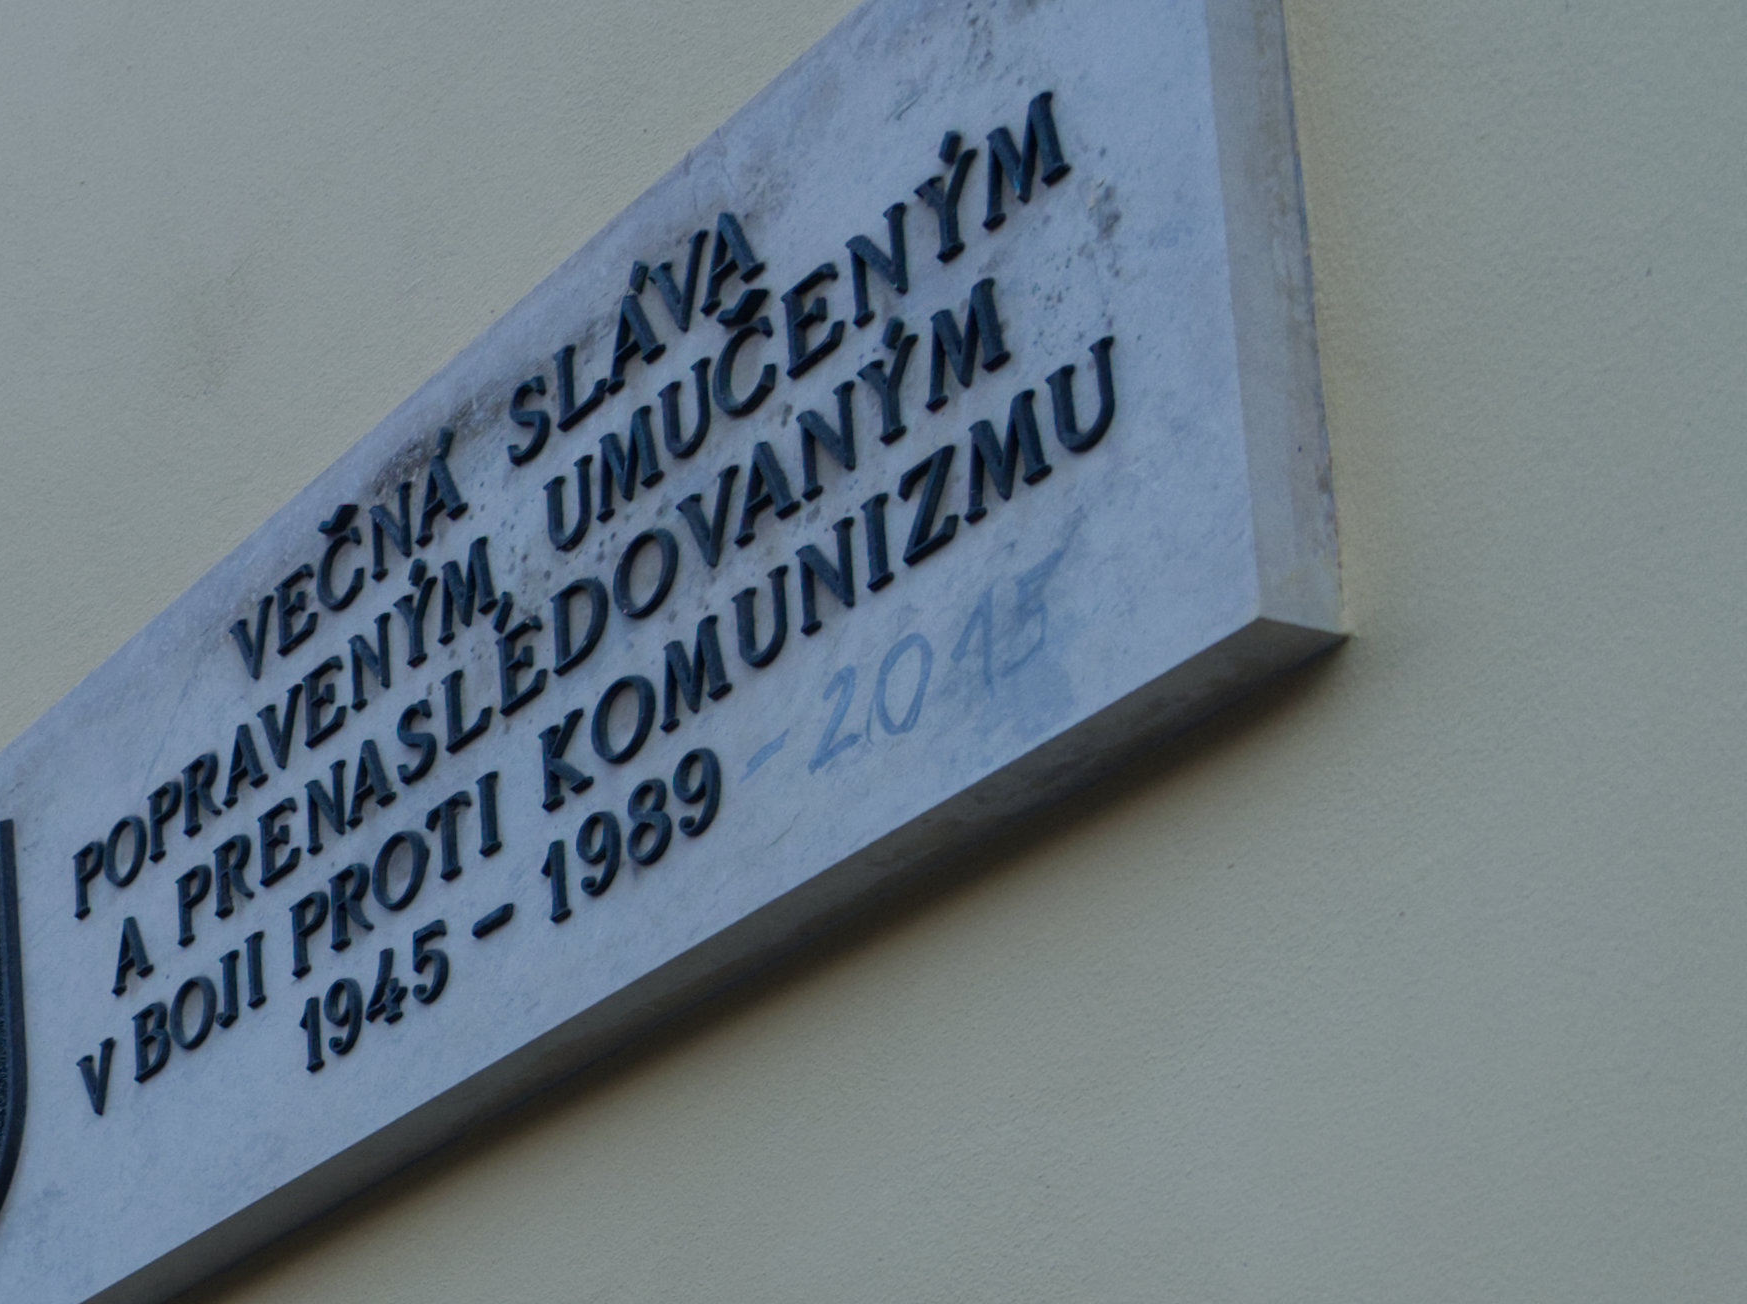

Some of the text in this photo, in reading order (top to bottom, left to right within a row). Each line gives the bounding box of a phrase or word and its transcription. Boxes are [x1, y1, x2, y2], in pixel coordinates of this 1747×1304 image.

[228, 212, 765, 681] VEČNÁ SLÁVA
[543, 90, 1072, 554] UMUČENÝM
[76, 335, 1116, 1116] V BOJI PROTI KOMUNIZMU
[111, 277, 1012, 997] A PRENASLEDOVANÝM
[300, 919, 451, 1074] 1945
[541, 747, 722, 925] 1989
